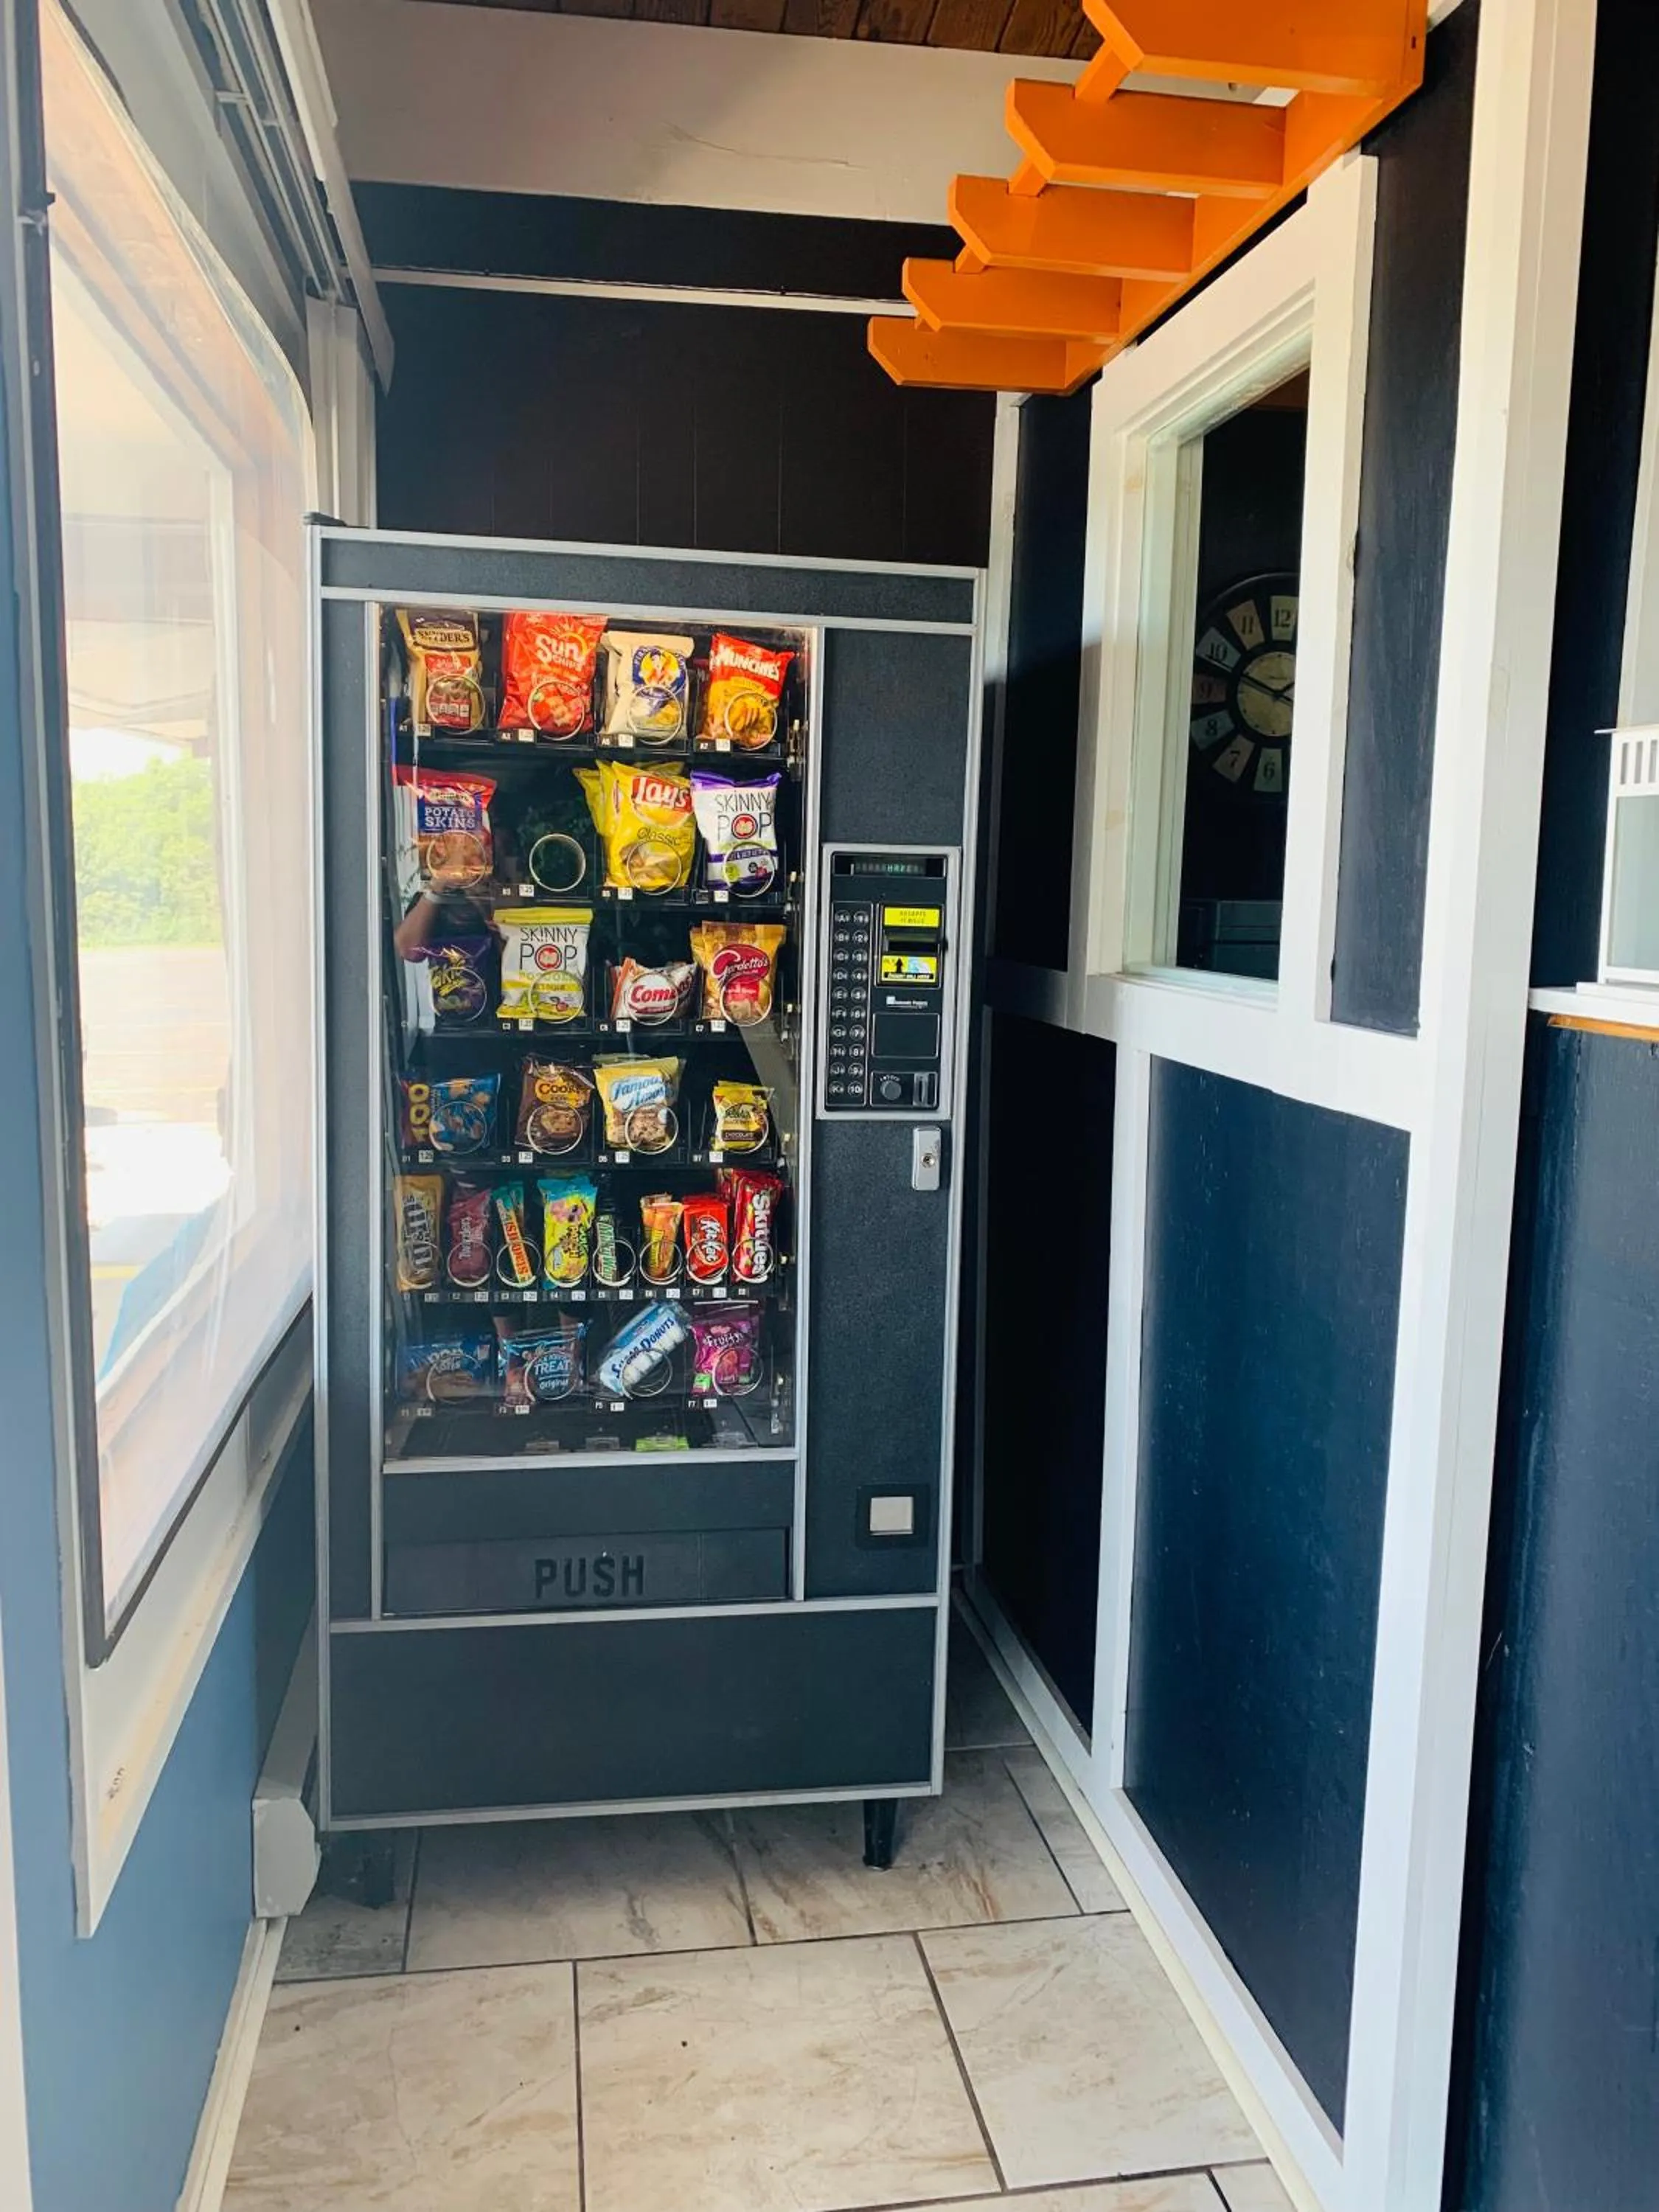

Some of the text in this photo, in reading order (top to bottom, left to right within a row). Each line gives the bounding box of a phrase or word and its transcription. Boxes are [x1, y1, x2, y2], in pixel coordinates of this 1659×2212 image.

[1241, 614, 1254, 636] 11
[1273, 608, 1295, 627] 12
[1208, 641, 1228, 662] 10
[1206, 719, 1218, 735] 8
[1229, 750, 1240, 768] 7
[1264, 761, 1276, 782] 6
[425, 806, 476, 818] POTATO
[714, 792, 773, 812] SKINNY
[425, 816, 476, 829] SKINS
[717, 812, 772, 841] POP
[520, 926, 578, 944] SKINNY
[519, 943, 578, 972] POP
[639, 1316, 675, 1351] DONUTS
[535, 1554, 644, 1600] PUSH
